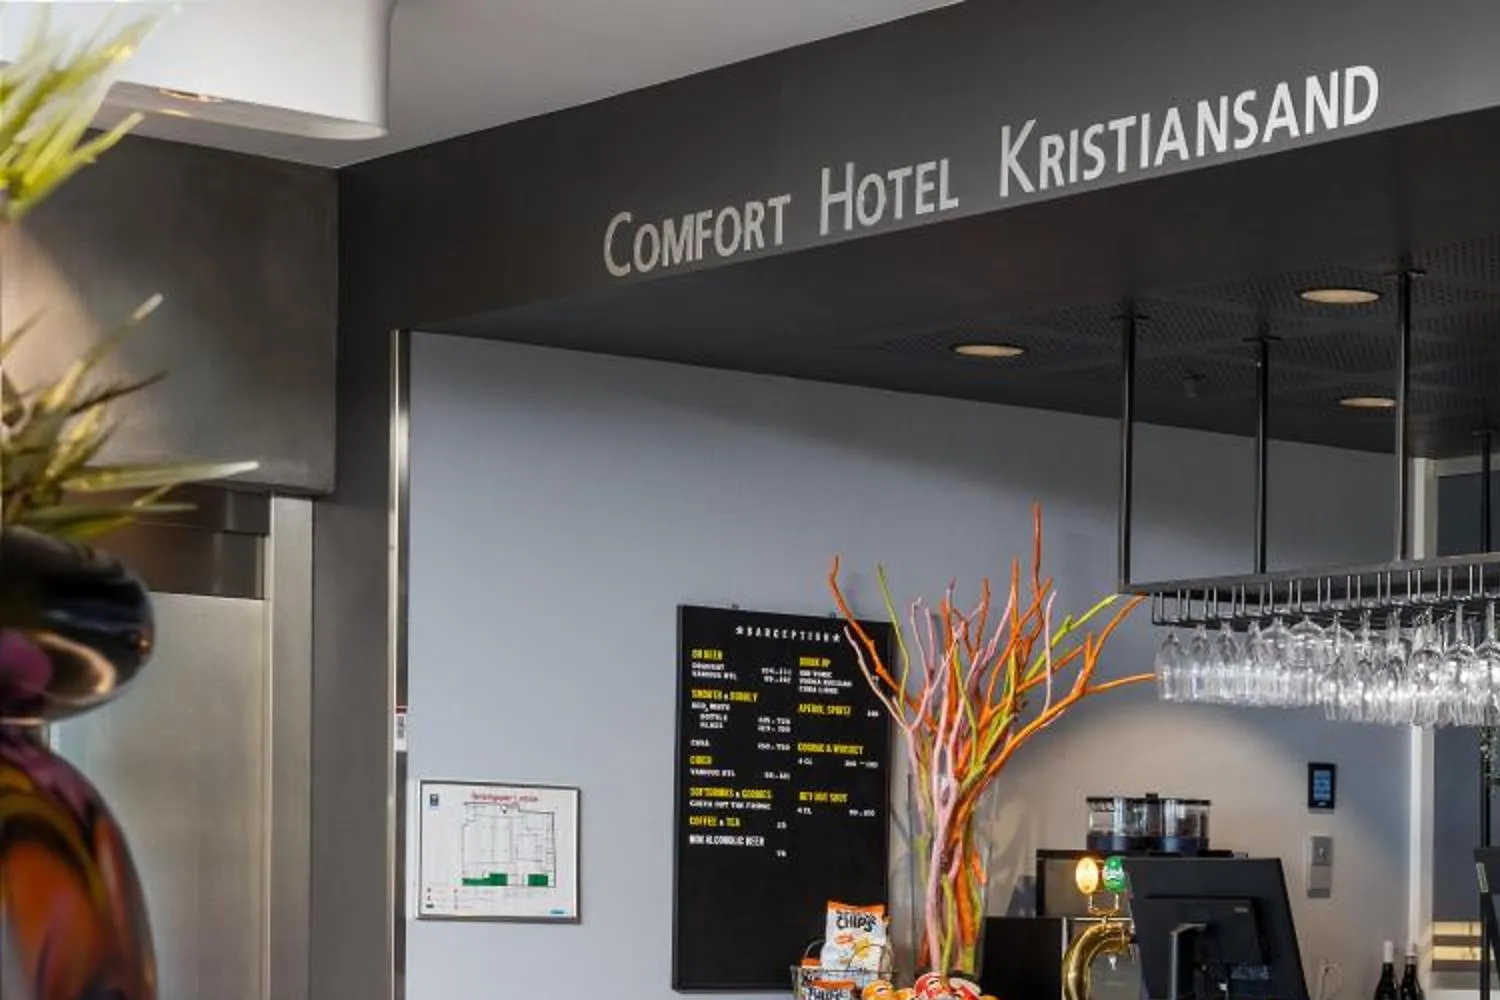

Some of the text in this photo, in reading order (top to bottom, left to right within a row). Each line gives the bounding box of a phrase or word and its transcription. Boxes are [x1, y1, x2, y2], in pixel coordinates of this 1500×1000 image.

[603, 65, 1380, 277] COMFORT HOTEL KRISTIANSAND
[836, 914, 874, 933] CHIPS
